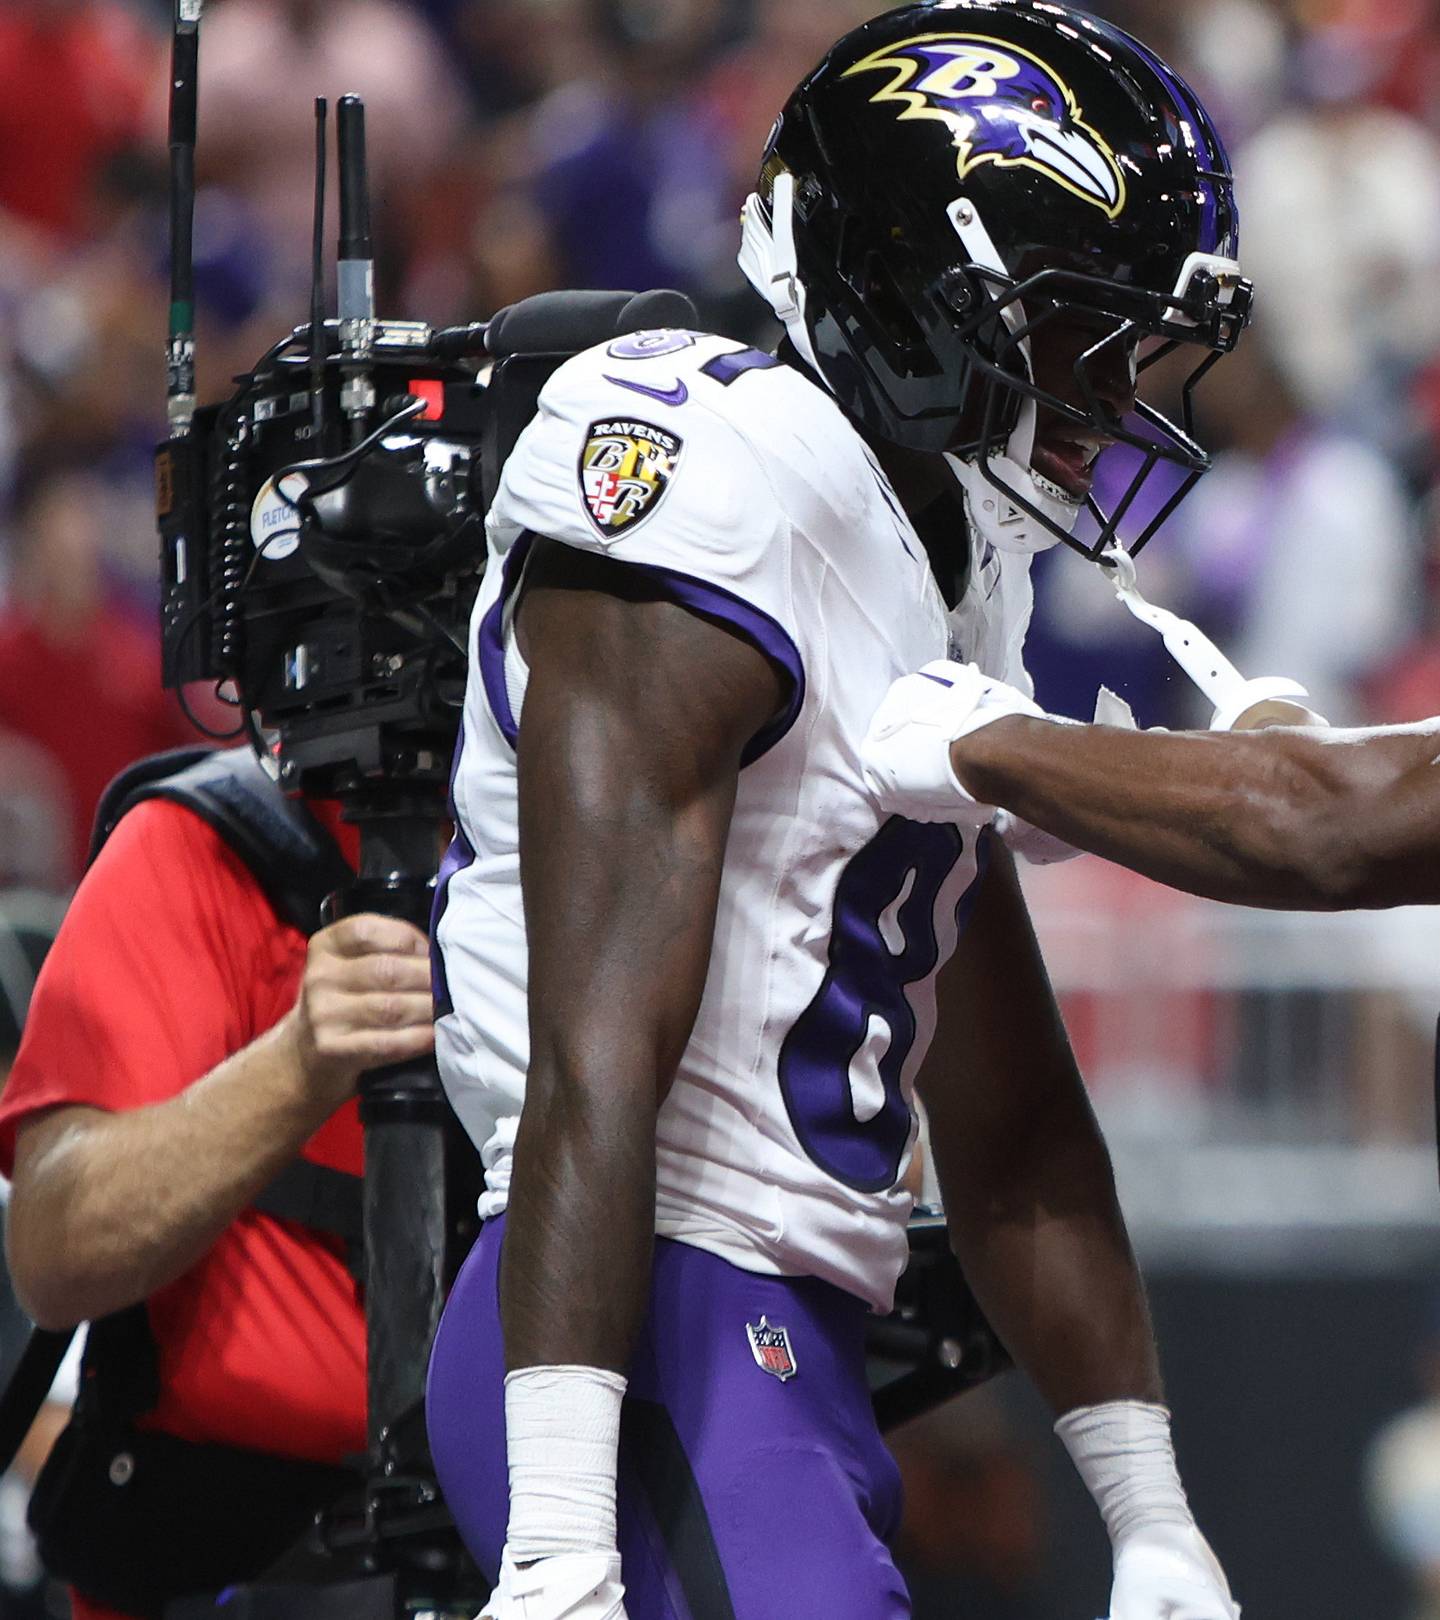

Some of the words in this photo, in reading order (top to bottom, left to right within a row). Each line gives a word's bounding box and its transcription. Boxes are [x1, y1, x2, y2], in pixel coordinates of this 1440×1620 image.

[916, 44, 1020, 98] B
[587, 437, 629, 472] B
[593, 422, 674, 450] RAVENS
[614, 479, 654, 517] R
[777, 814, 990, 1194] 8
